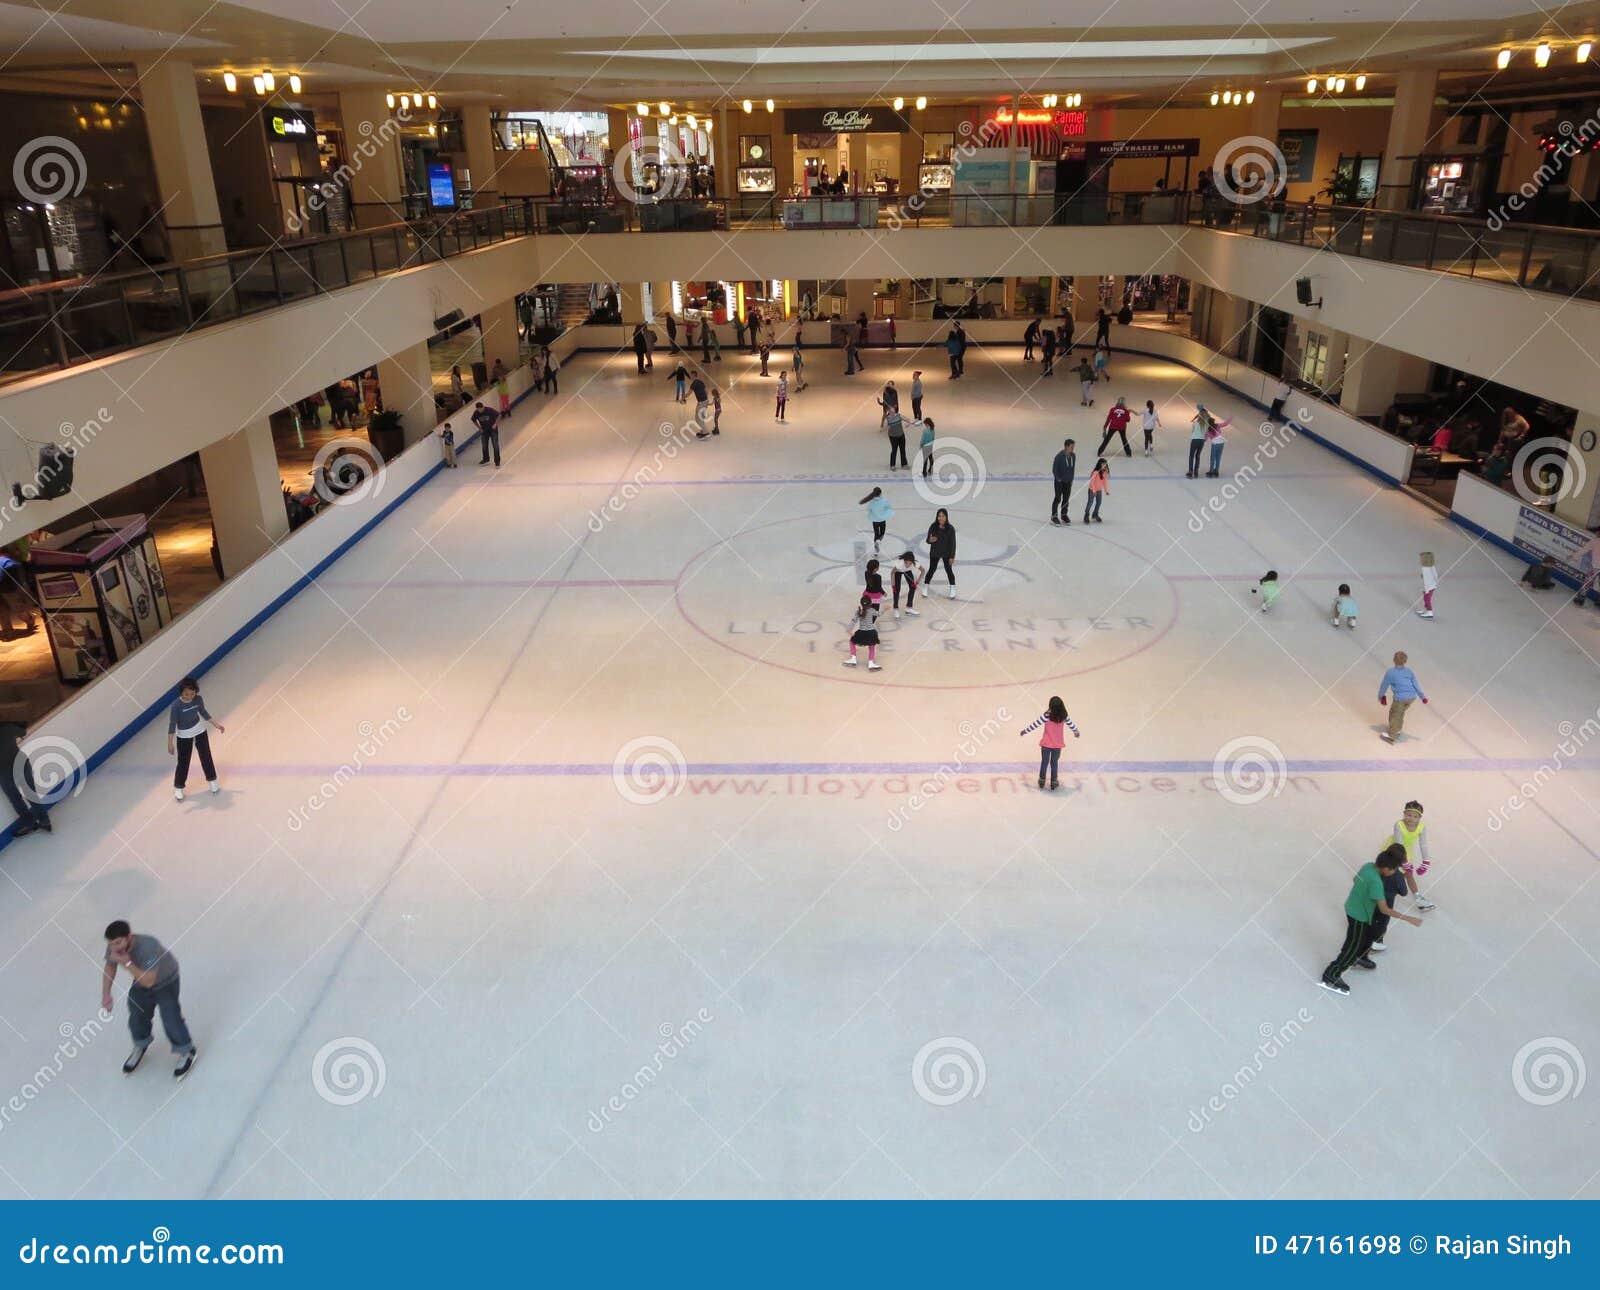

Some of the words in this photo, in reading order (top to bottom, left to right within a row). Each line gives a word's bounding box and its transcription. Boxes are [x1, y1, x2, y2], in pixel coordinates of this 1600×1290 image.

[1524, 509, 1548, 529] Learn
[1549, 522, 1560, 533] to
[927, 617, 1154, 633] CENTER
[941, 638, 1078, 652] RINK
